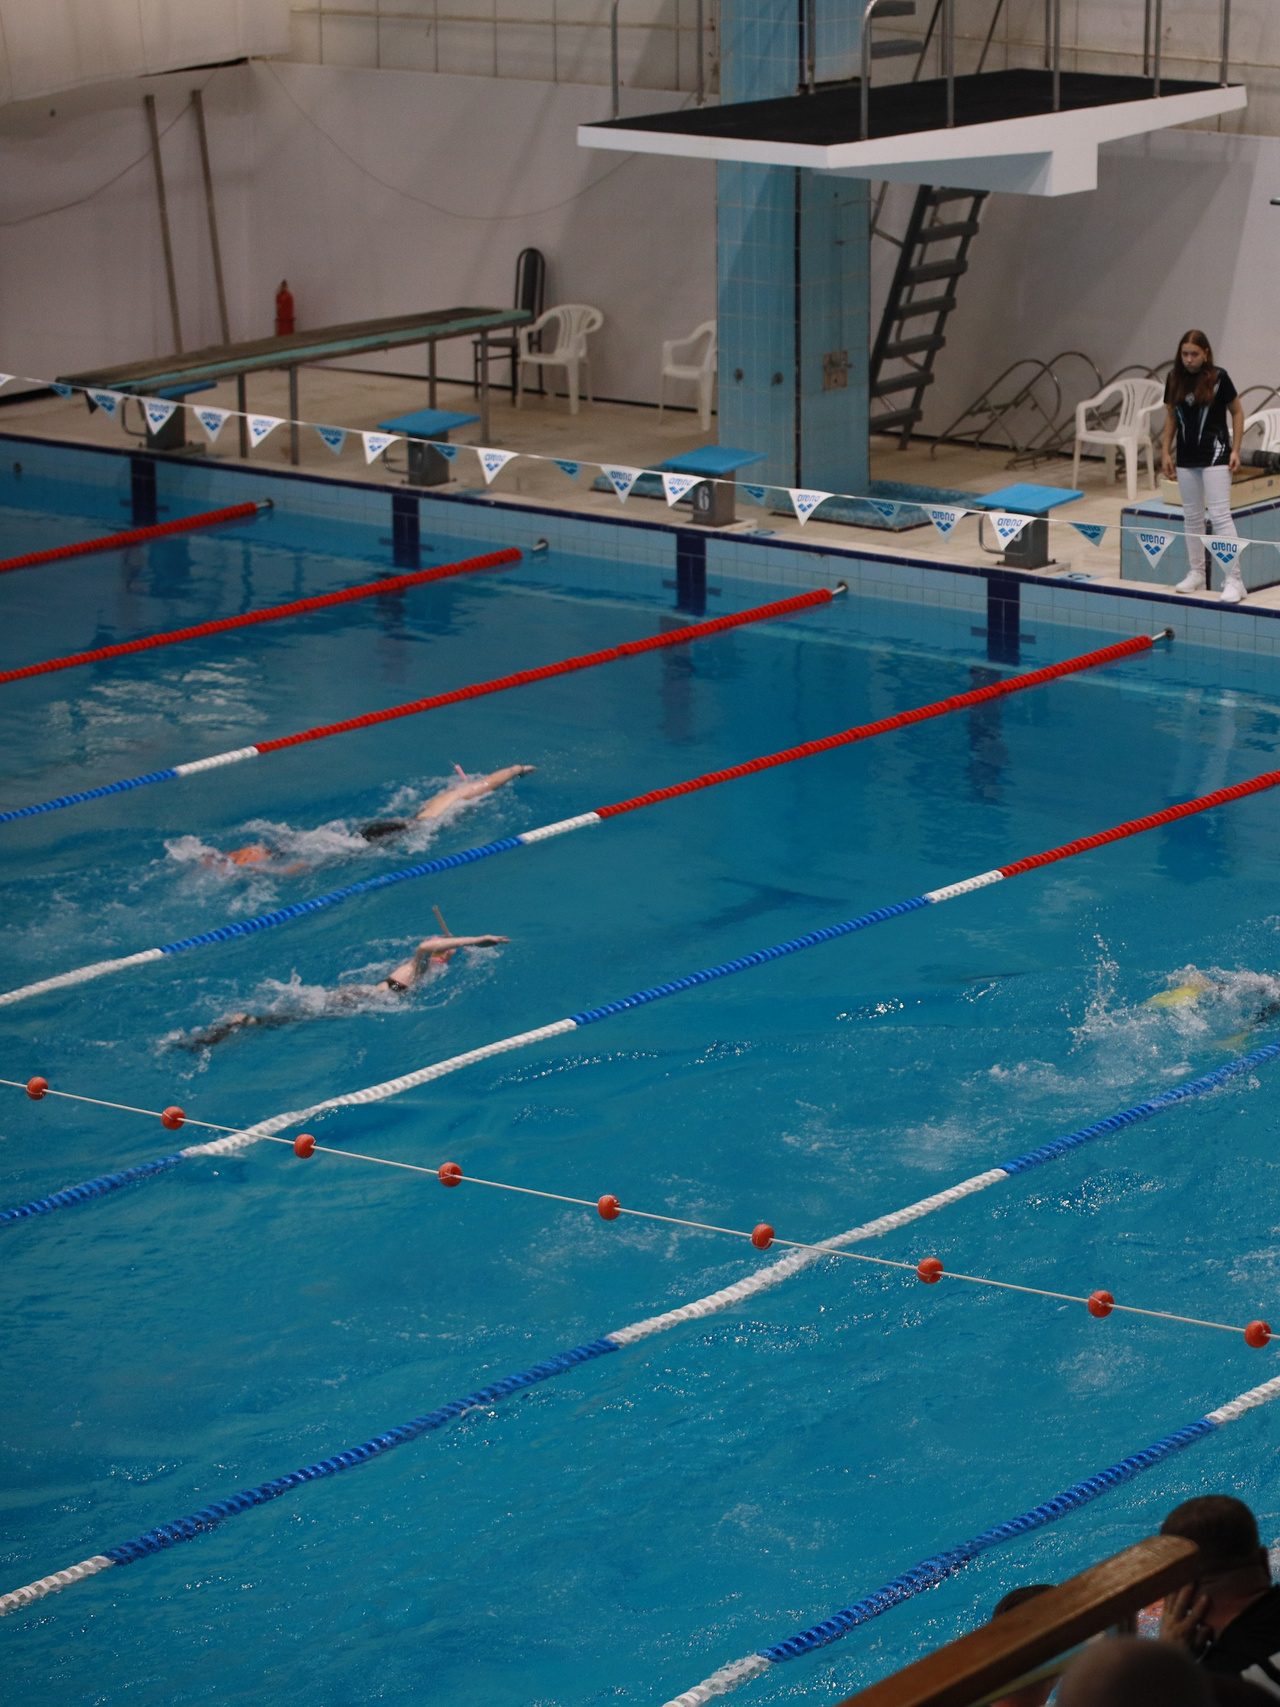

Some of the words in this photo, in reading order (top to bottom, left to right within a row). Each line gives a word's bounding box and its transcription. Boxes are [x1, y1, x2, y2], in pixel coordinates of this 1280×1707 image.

[610, 470, 632, 482] arena
[668, 477, 692, 486] arena
[797, 494, 820, 502] arena
[932, 510, 955, 522] arena
[997, 517, 1023, 527] arena
[1140, 533, 1165, 545] arena
[1211, 541, 1238, 553] arena
